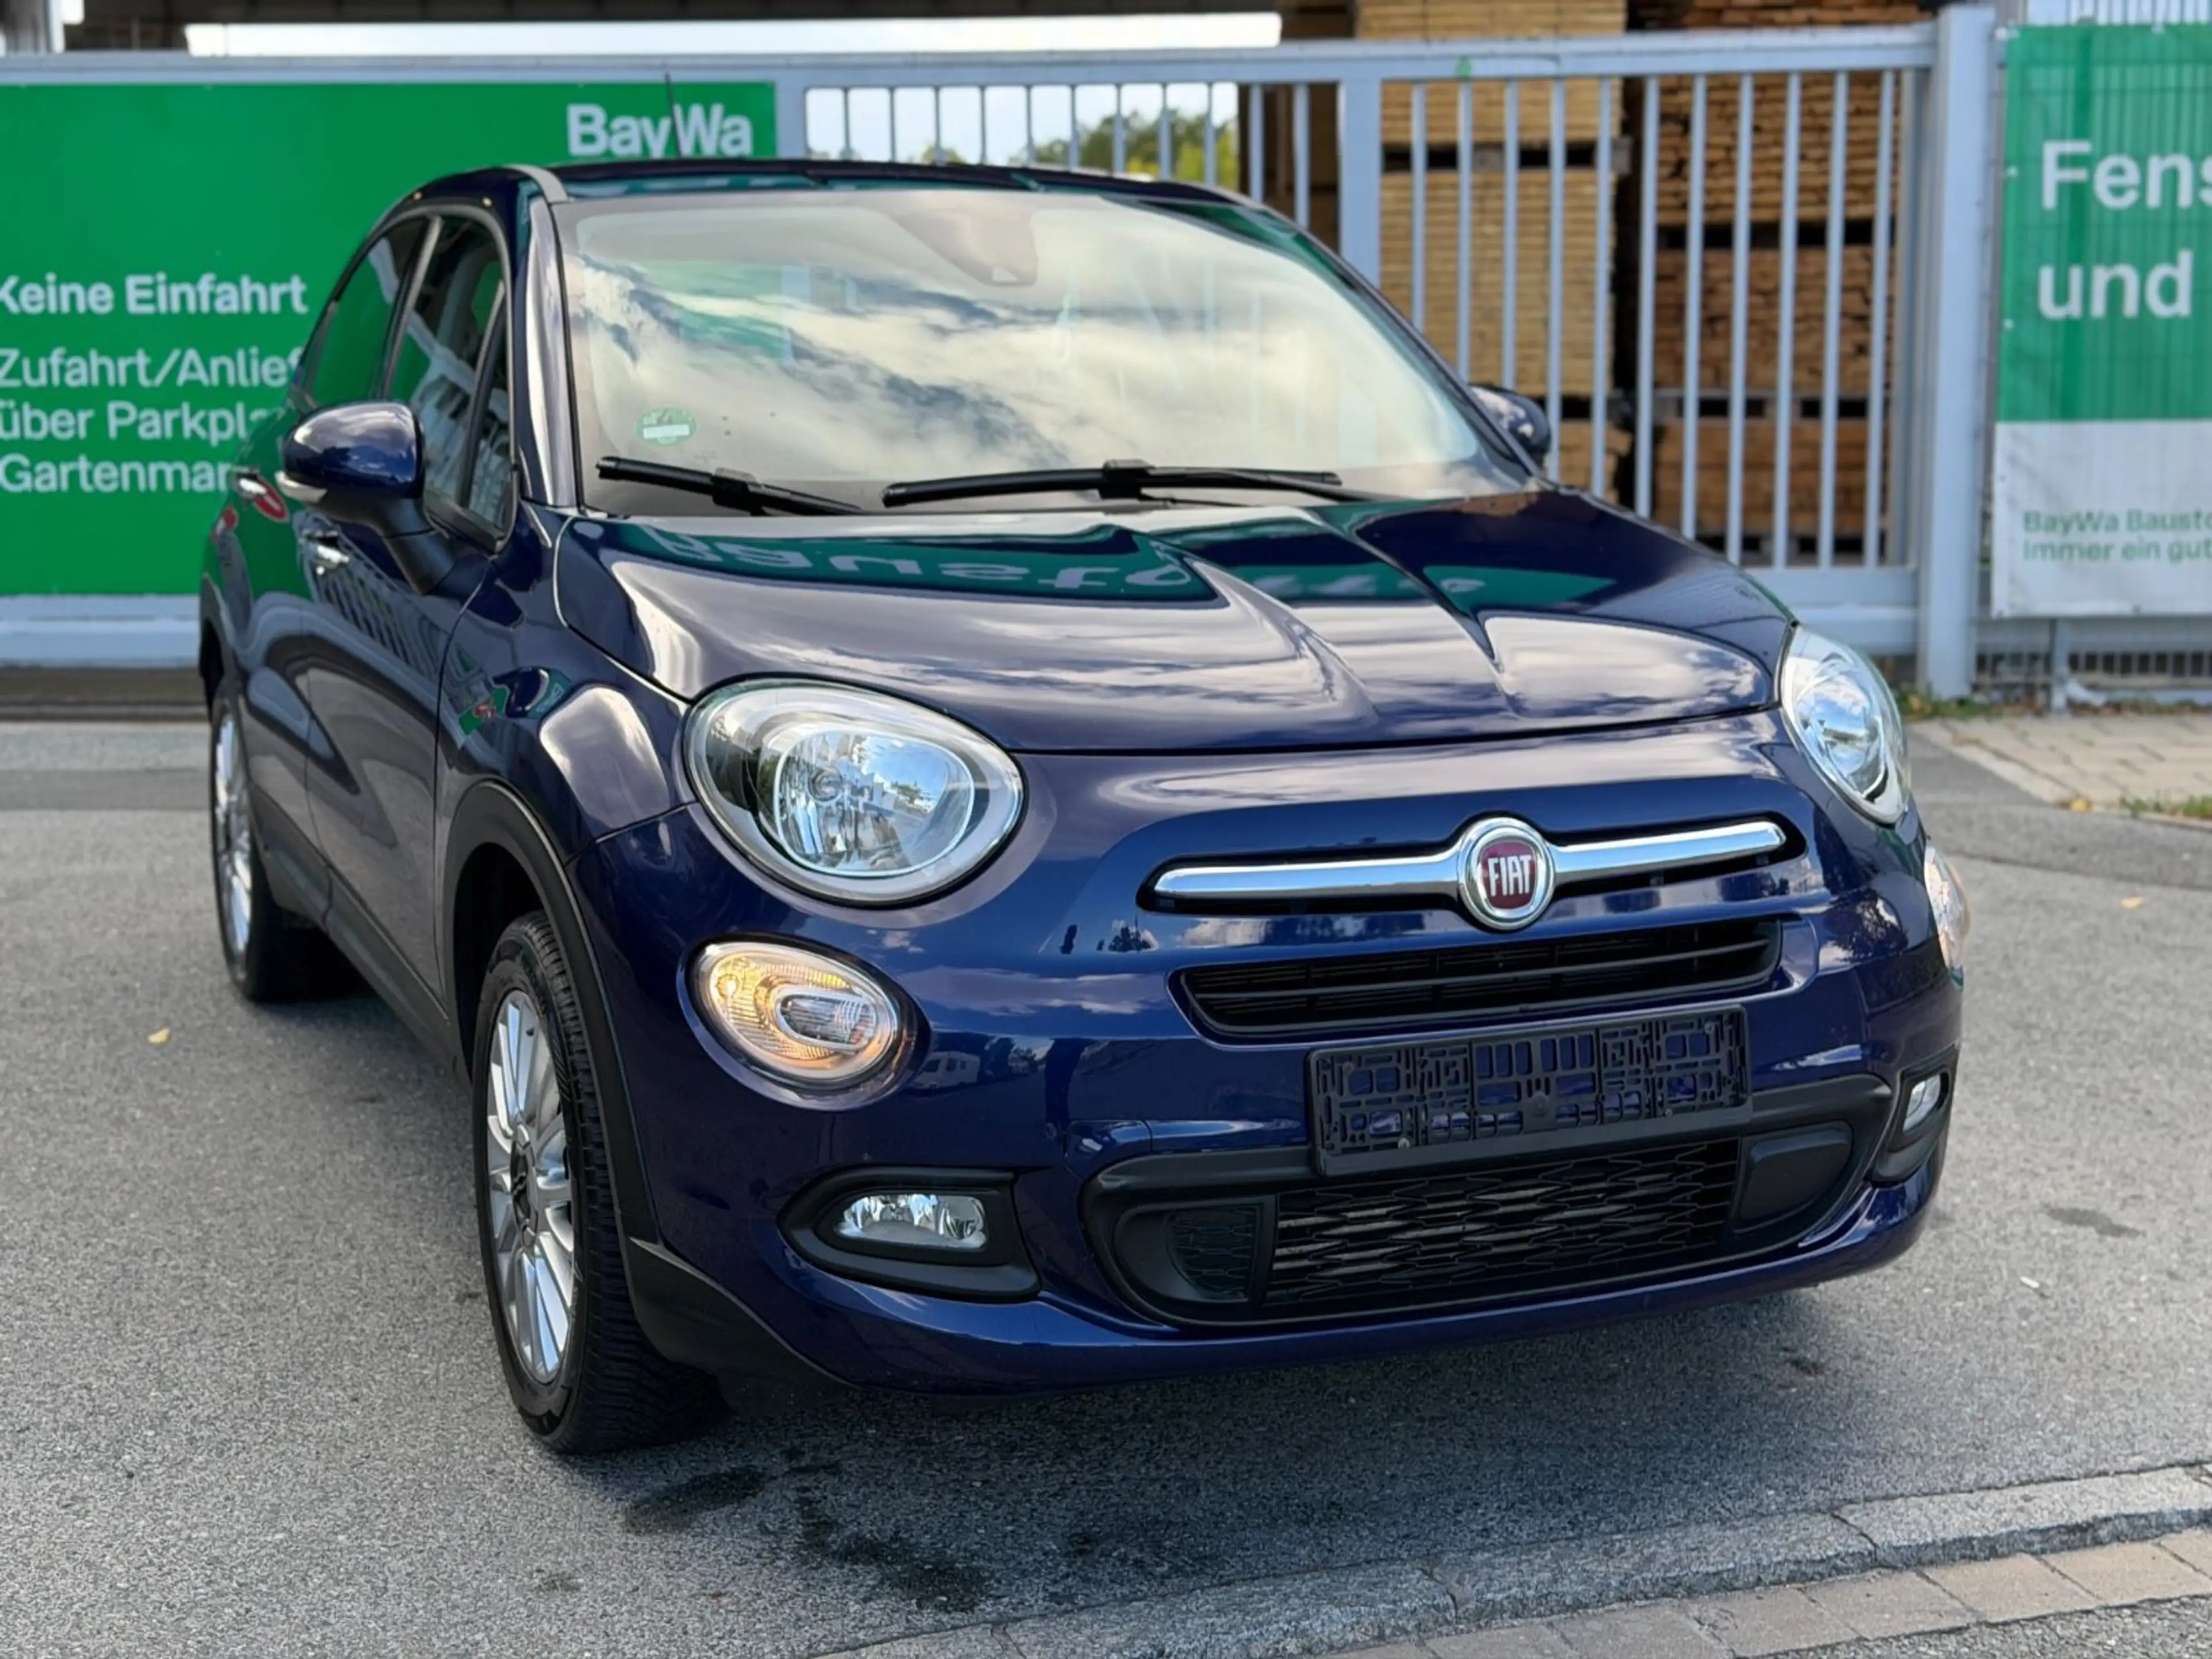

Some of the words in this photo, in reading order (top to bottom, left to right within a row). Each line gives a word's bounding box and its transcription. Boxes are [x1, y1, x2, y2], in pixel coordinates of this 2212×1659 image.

[567, 103, 753, 160] BayWa
[0, 271, 114, 315] Keine
[125, 271, 308, 315] Einfahrt
[2039, 249, 2193, 320] und
[0, 398, 94, 440] über
[107, 400, 268, 447] Parkpl
[2023, 509, 2120, 536] BayWa
[2022, 539, 2115, 561] Immer
[2121, 536, 2161, 560] ein
[1487, 854, 1533, 897] FIAT
